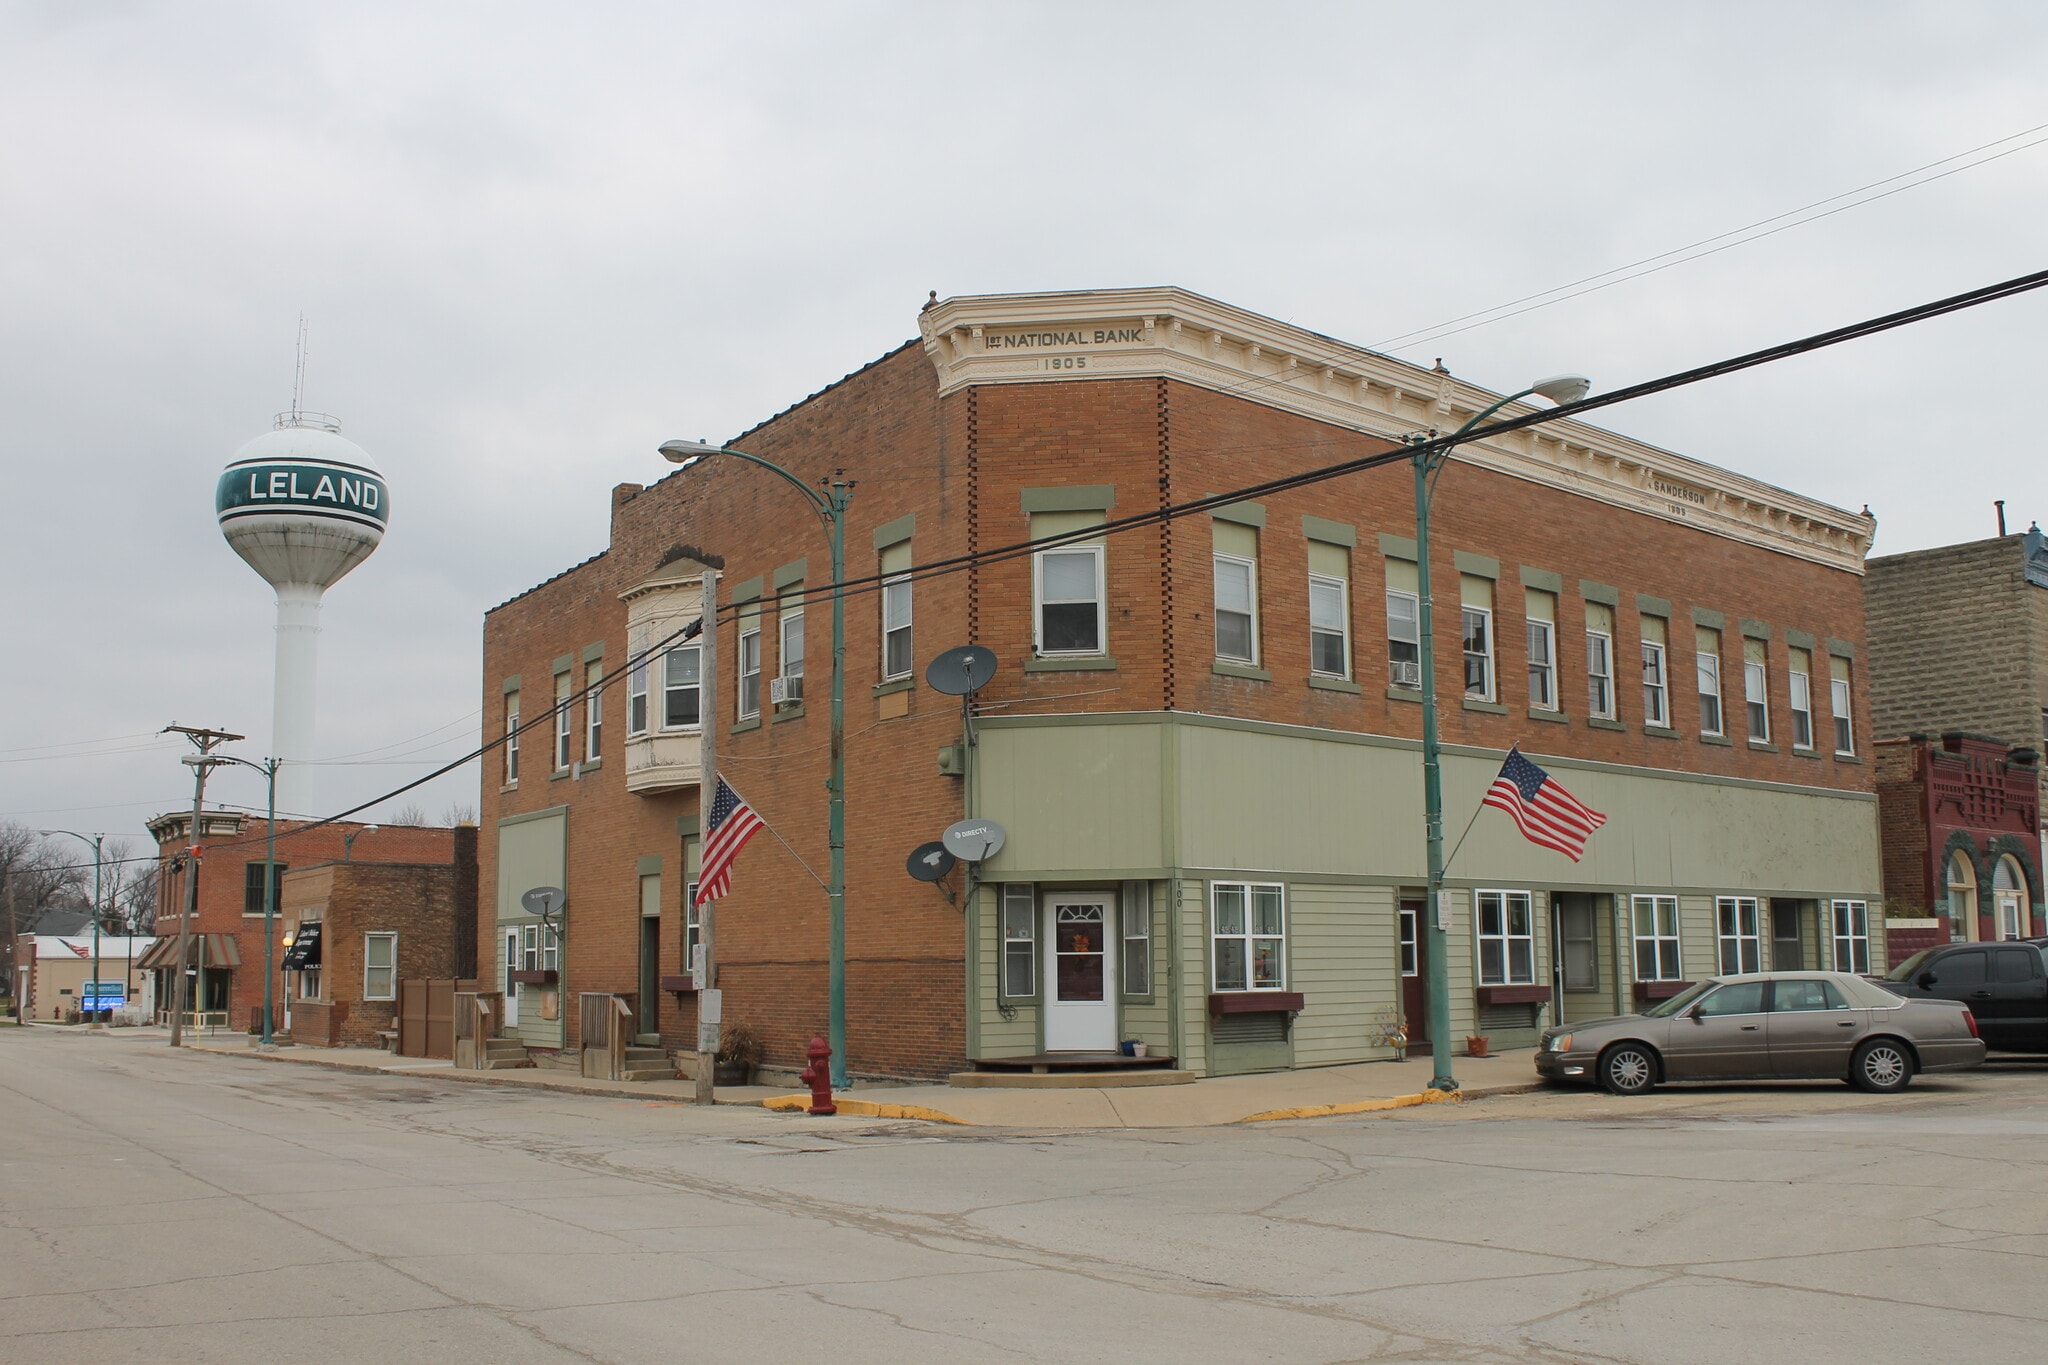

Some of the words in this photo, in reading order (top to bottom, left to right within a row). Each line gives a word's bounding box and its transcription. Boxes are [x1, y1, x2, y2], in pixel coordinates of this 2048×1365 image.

[1045, 357, 1087, 370] 1905
[250, 472, 379, 511] LELAND
[1654, 481, 1705, 505] SANDERSON
[1667, 504, 1687, 516] 1905
[961, 827, 987, 838] DIRECTV
